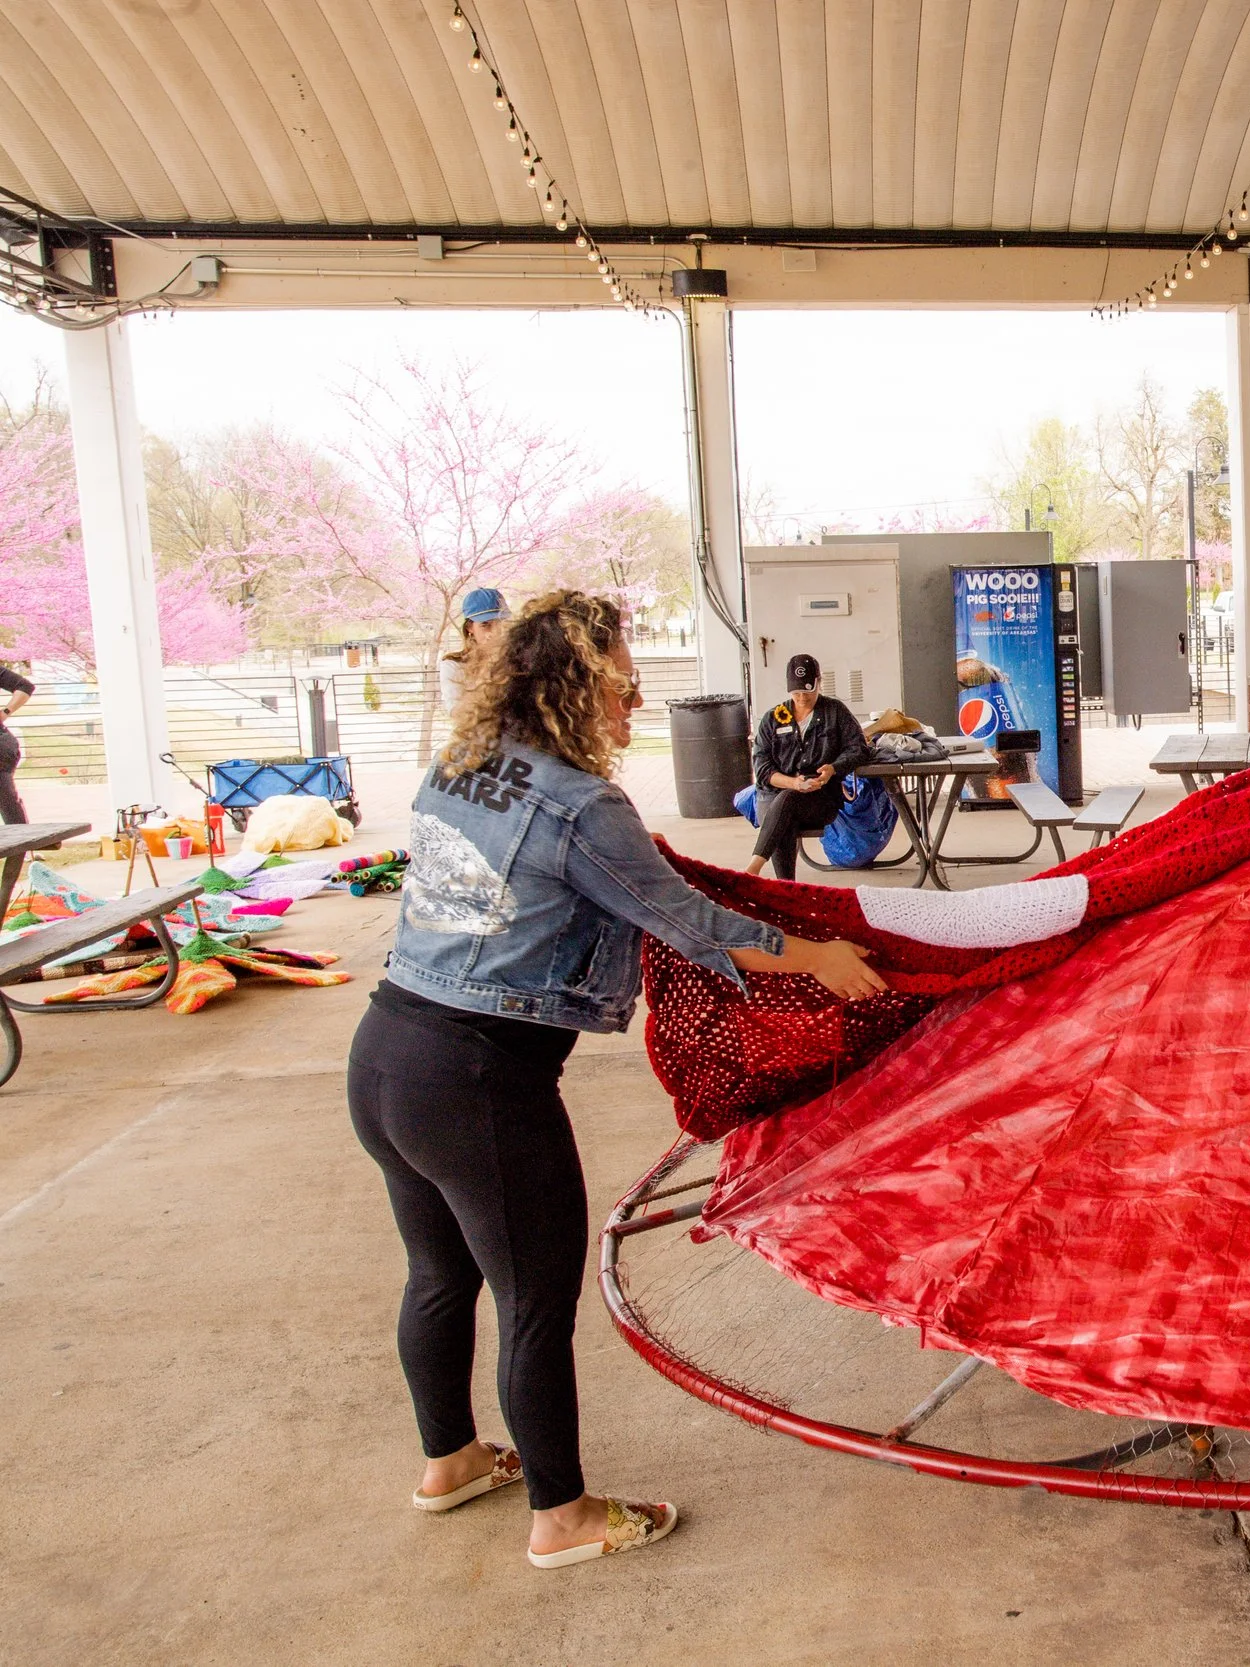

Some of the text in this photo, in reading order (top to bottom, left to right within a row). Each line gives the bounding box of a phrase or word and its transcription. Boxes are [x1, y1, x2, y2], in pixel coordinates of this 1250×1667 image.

[965, 572, 1039, 590] WOOO
[966, 593, 1039, 605] PIG SOOIE!!!
[1016, 612, 1038, 620] pepsi
[993, 694, 1016, 730] pepsi
